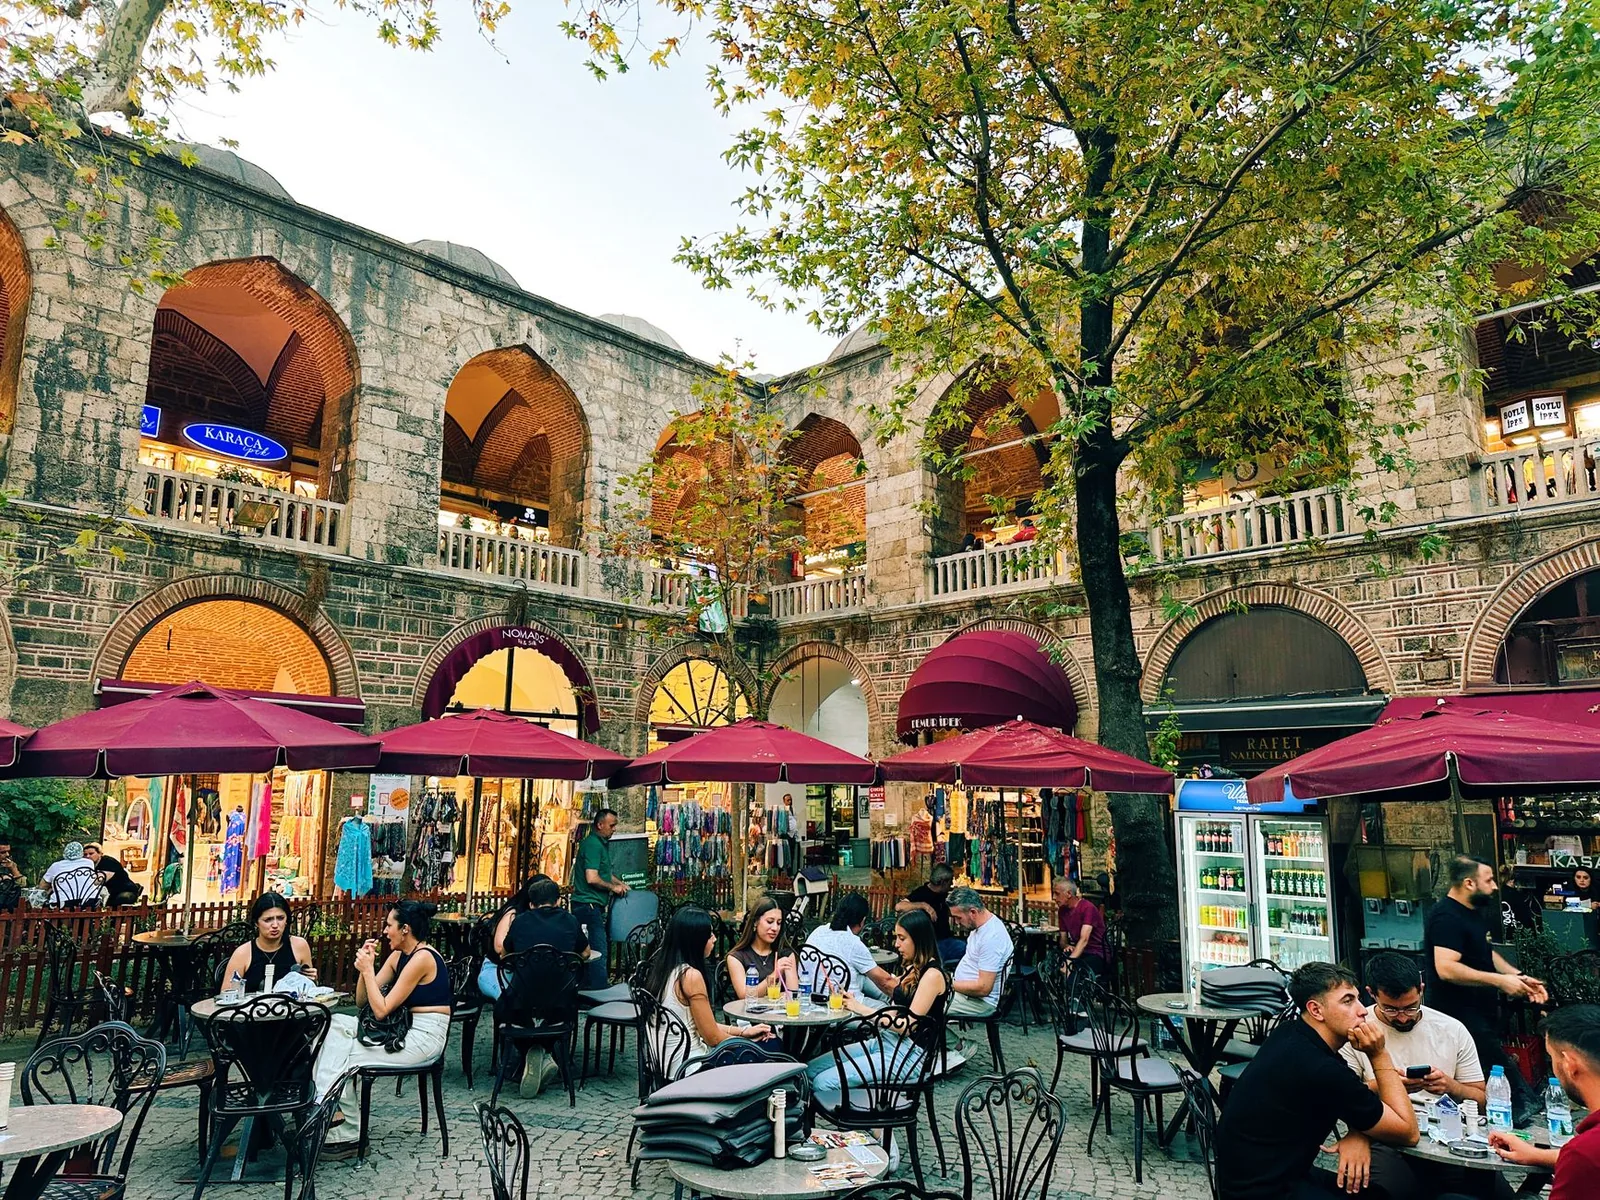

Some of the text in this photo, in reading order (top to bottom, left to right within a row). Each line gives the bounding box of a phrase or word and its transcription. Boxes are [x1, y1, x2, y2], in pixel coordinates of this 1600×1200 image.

[1503, 406, 1525, 420] SOYLU
[1535, 401, 1562, 412] SOYLU
[204, 426, 263, 450] KARACA
[502, 628, 546, 645] NOMADS
[939, 715, 962, 728] İPEK
[1247, 736, 1301, 750] RAFET
